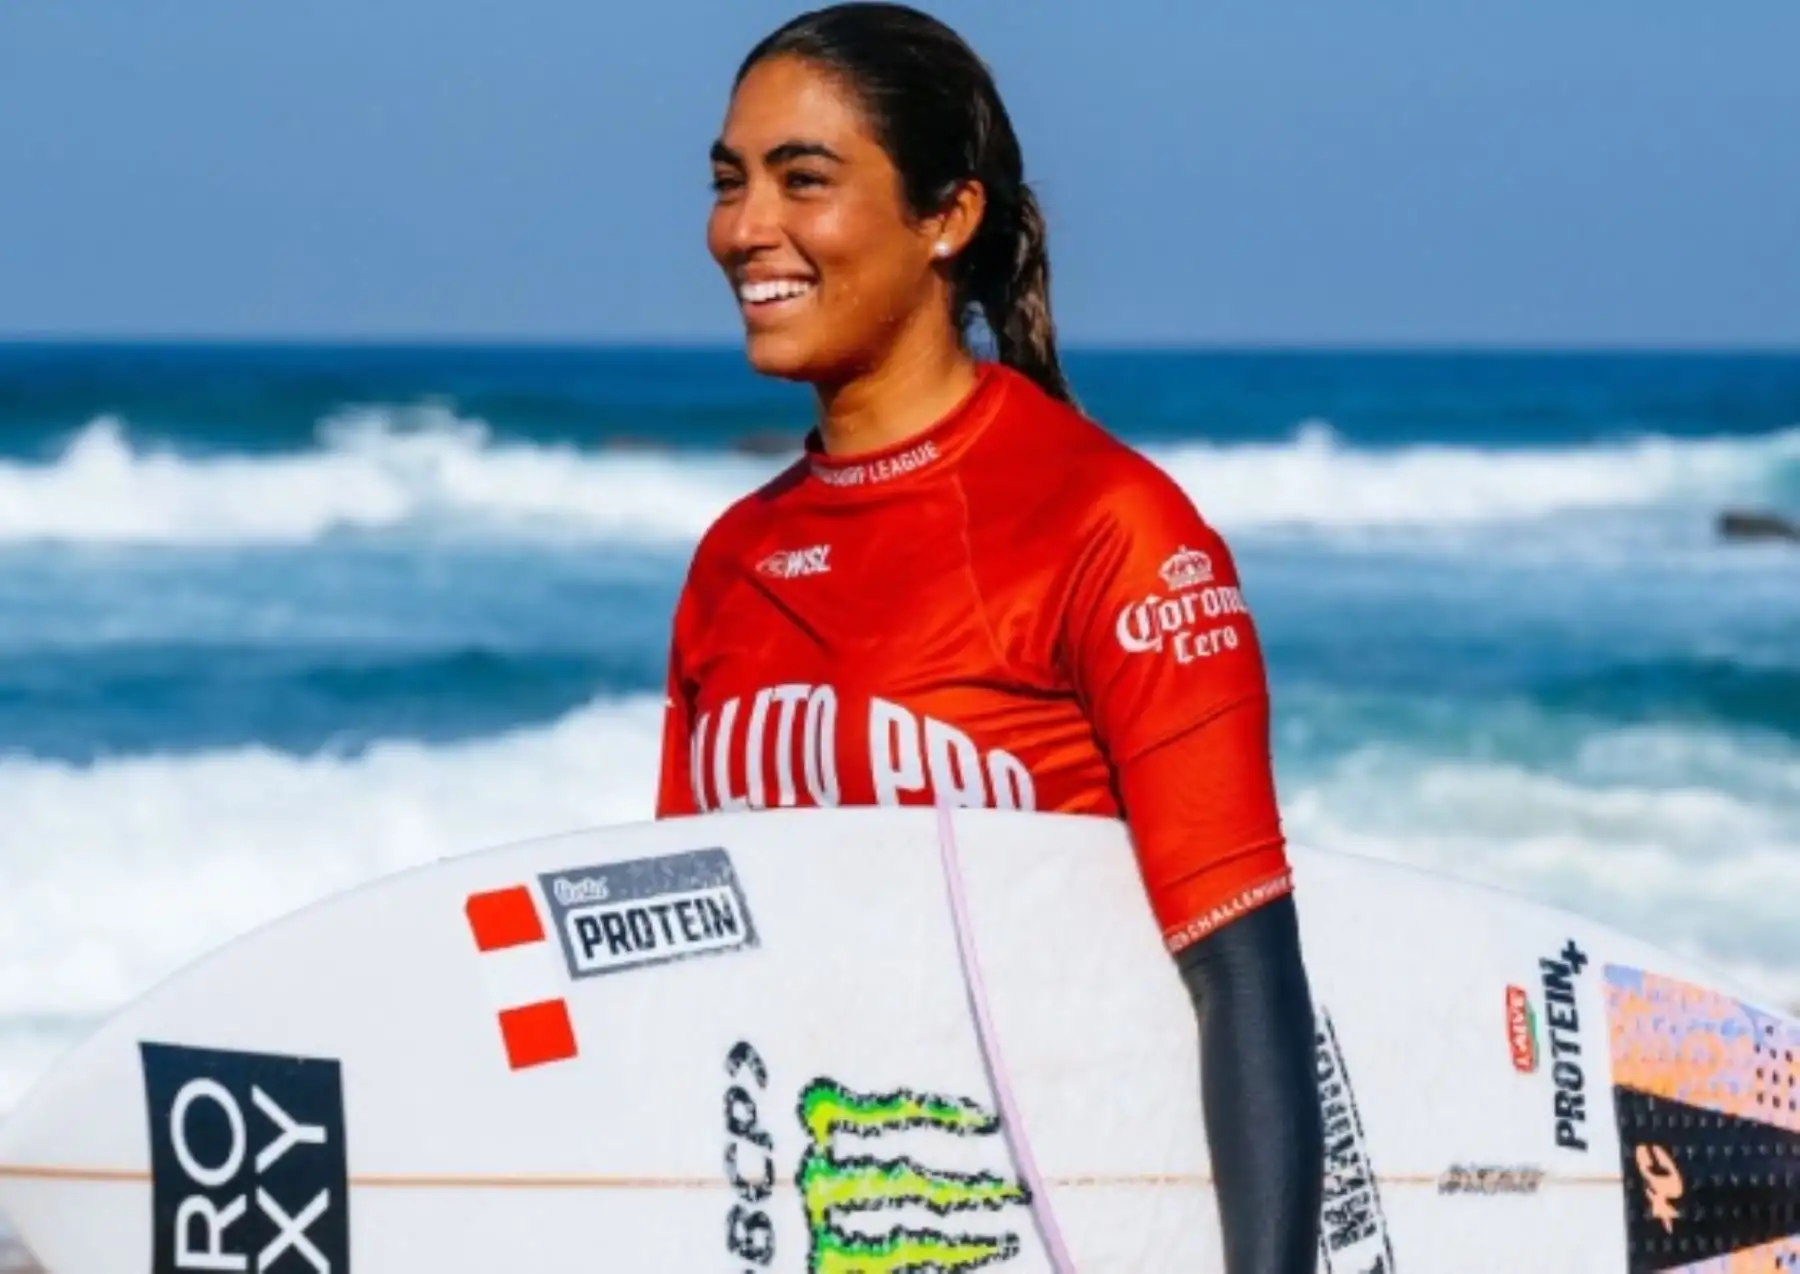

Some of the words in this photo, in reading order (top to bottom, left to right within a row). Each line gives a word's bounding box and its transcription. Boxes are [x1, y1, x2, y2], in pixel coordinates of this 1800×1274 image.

[868, 440, 939, 485] LEAGUE
[785, 543, 832, 580] WSL
[1173, 625, 1239, 665] Cero
[573, 893, 740, 960] PROTEIN
